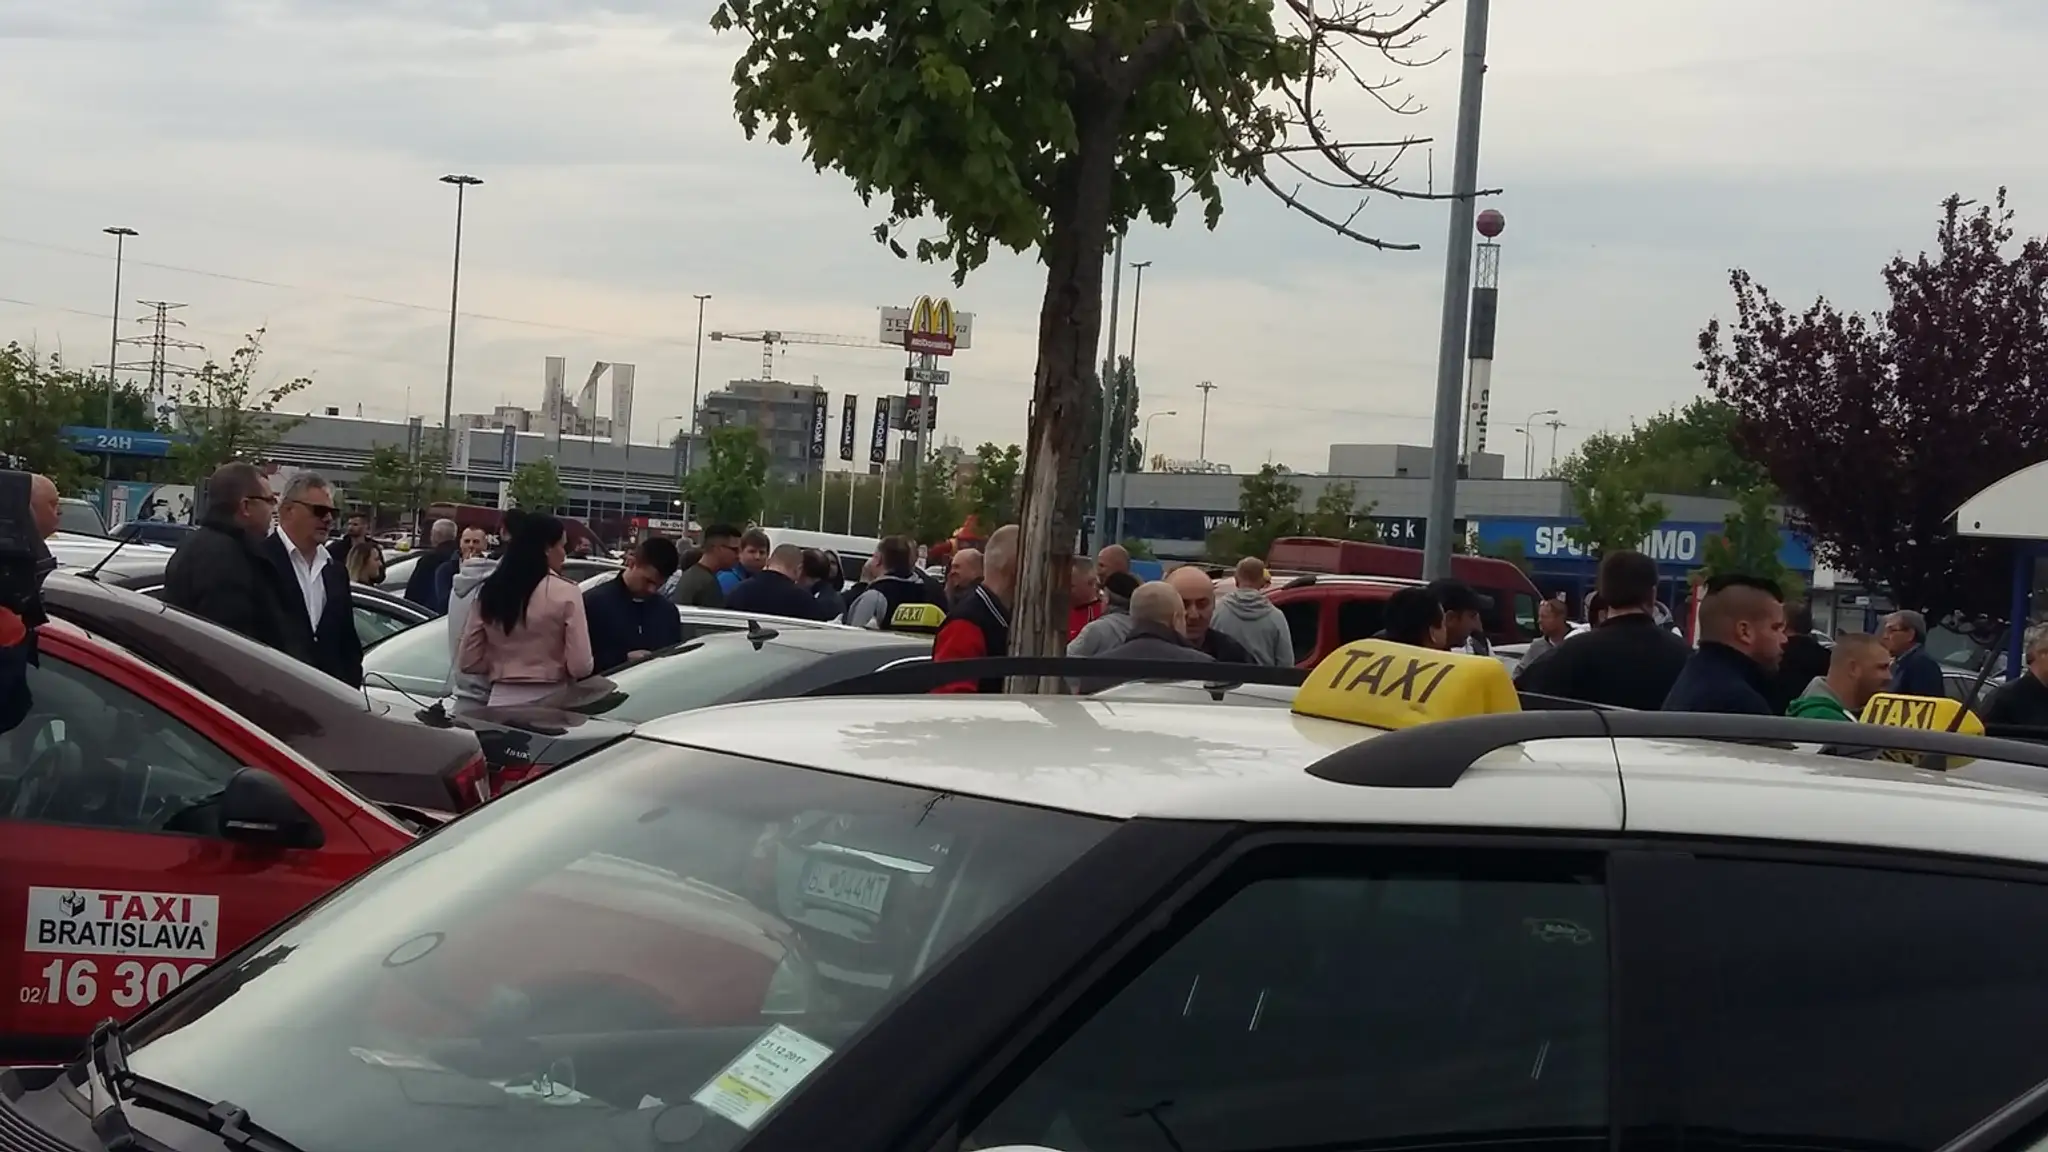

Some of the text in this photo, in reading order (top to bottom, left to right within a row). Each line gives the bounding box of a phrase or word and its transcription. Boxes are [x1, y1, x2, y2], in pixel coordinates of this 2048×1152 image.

[97, 435, 132, 449] 24H
[896, 607, 923, 620] TAXI
[1329, 649, 1455, 703] TAXI
[1873, 698, 1934, 729] TAXI
[98, 894, 191, 923] TAXI
[38, 918, 205, 950] BRATISLAVA
